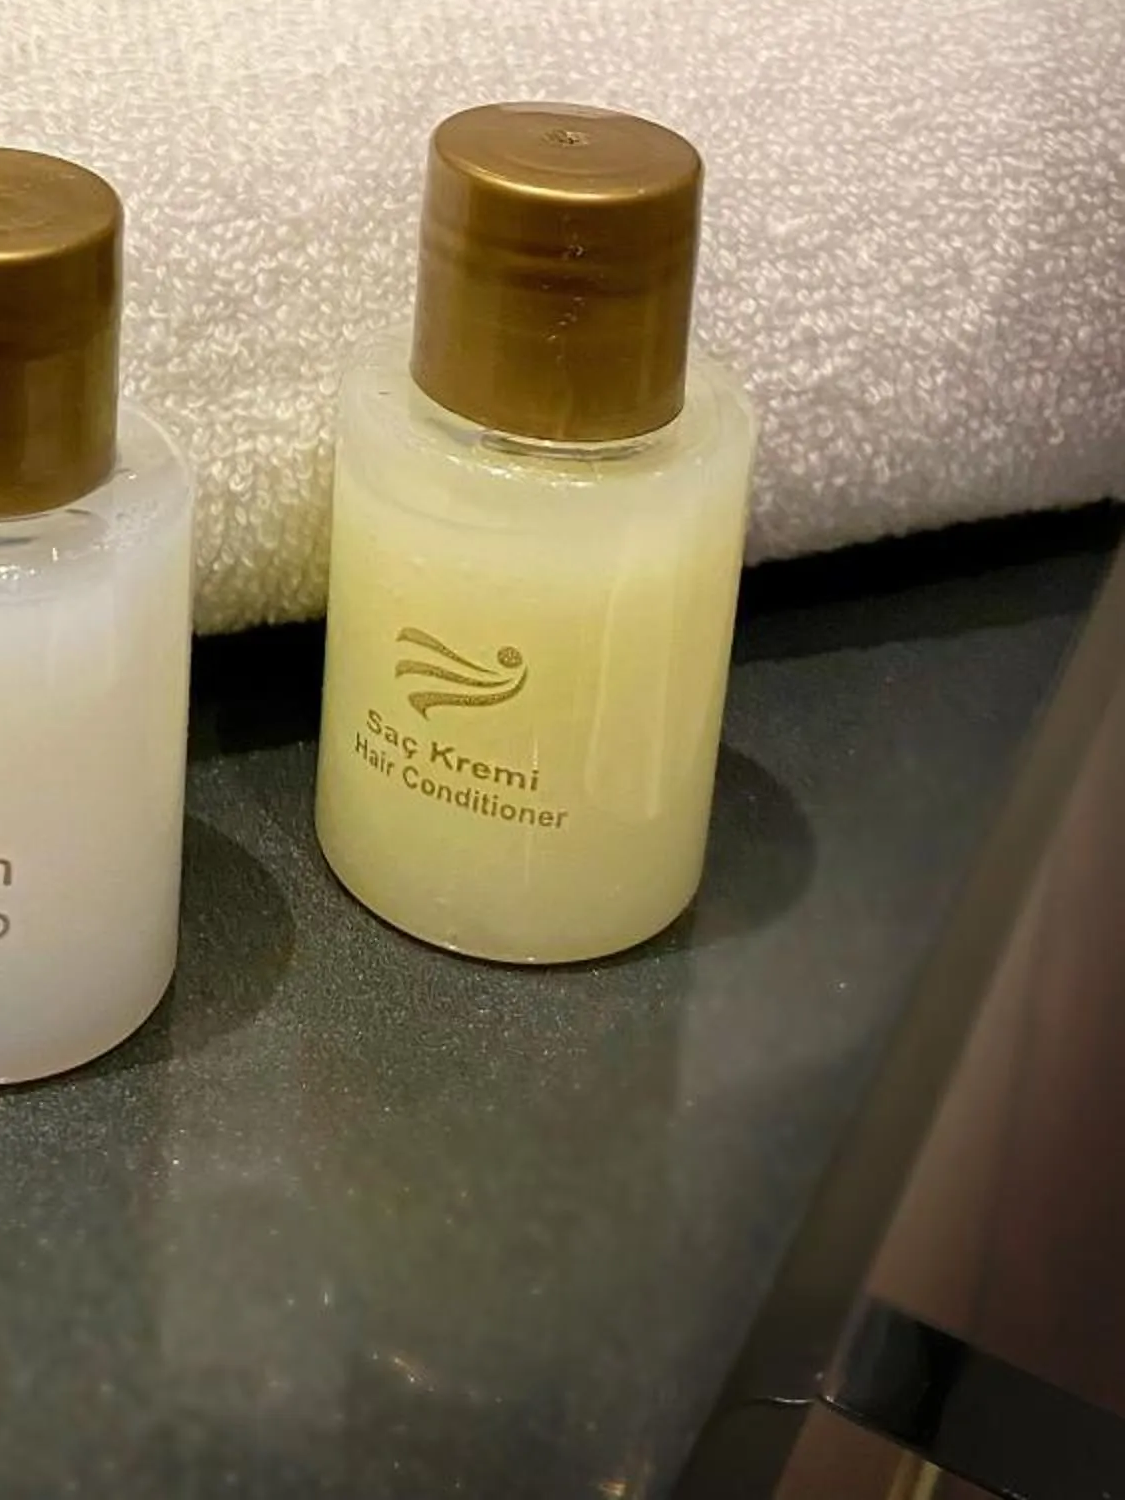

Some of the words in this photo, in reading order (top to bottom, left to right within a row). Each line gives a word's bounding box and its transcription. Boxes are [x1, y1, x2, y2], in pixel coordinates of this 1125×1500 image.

[354, 731, 395, 777] Hair
[402, 765, 569, 829] Conditioner
[366, 708, 419, 760] Saç
[430, 741, 540, 792] Kremi
